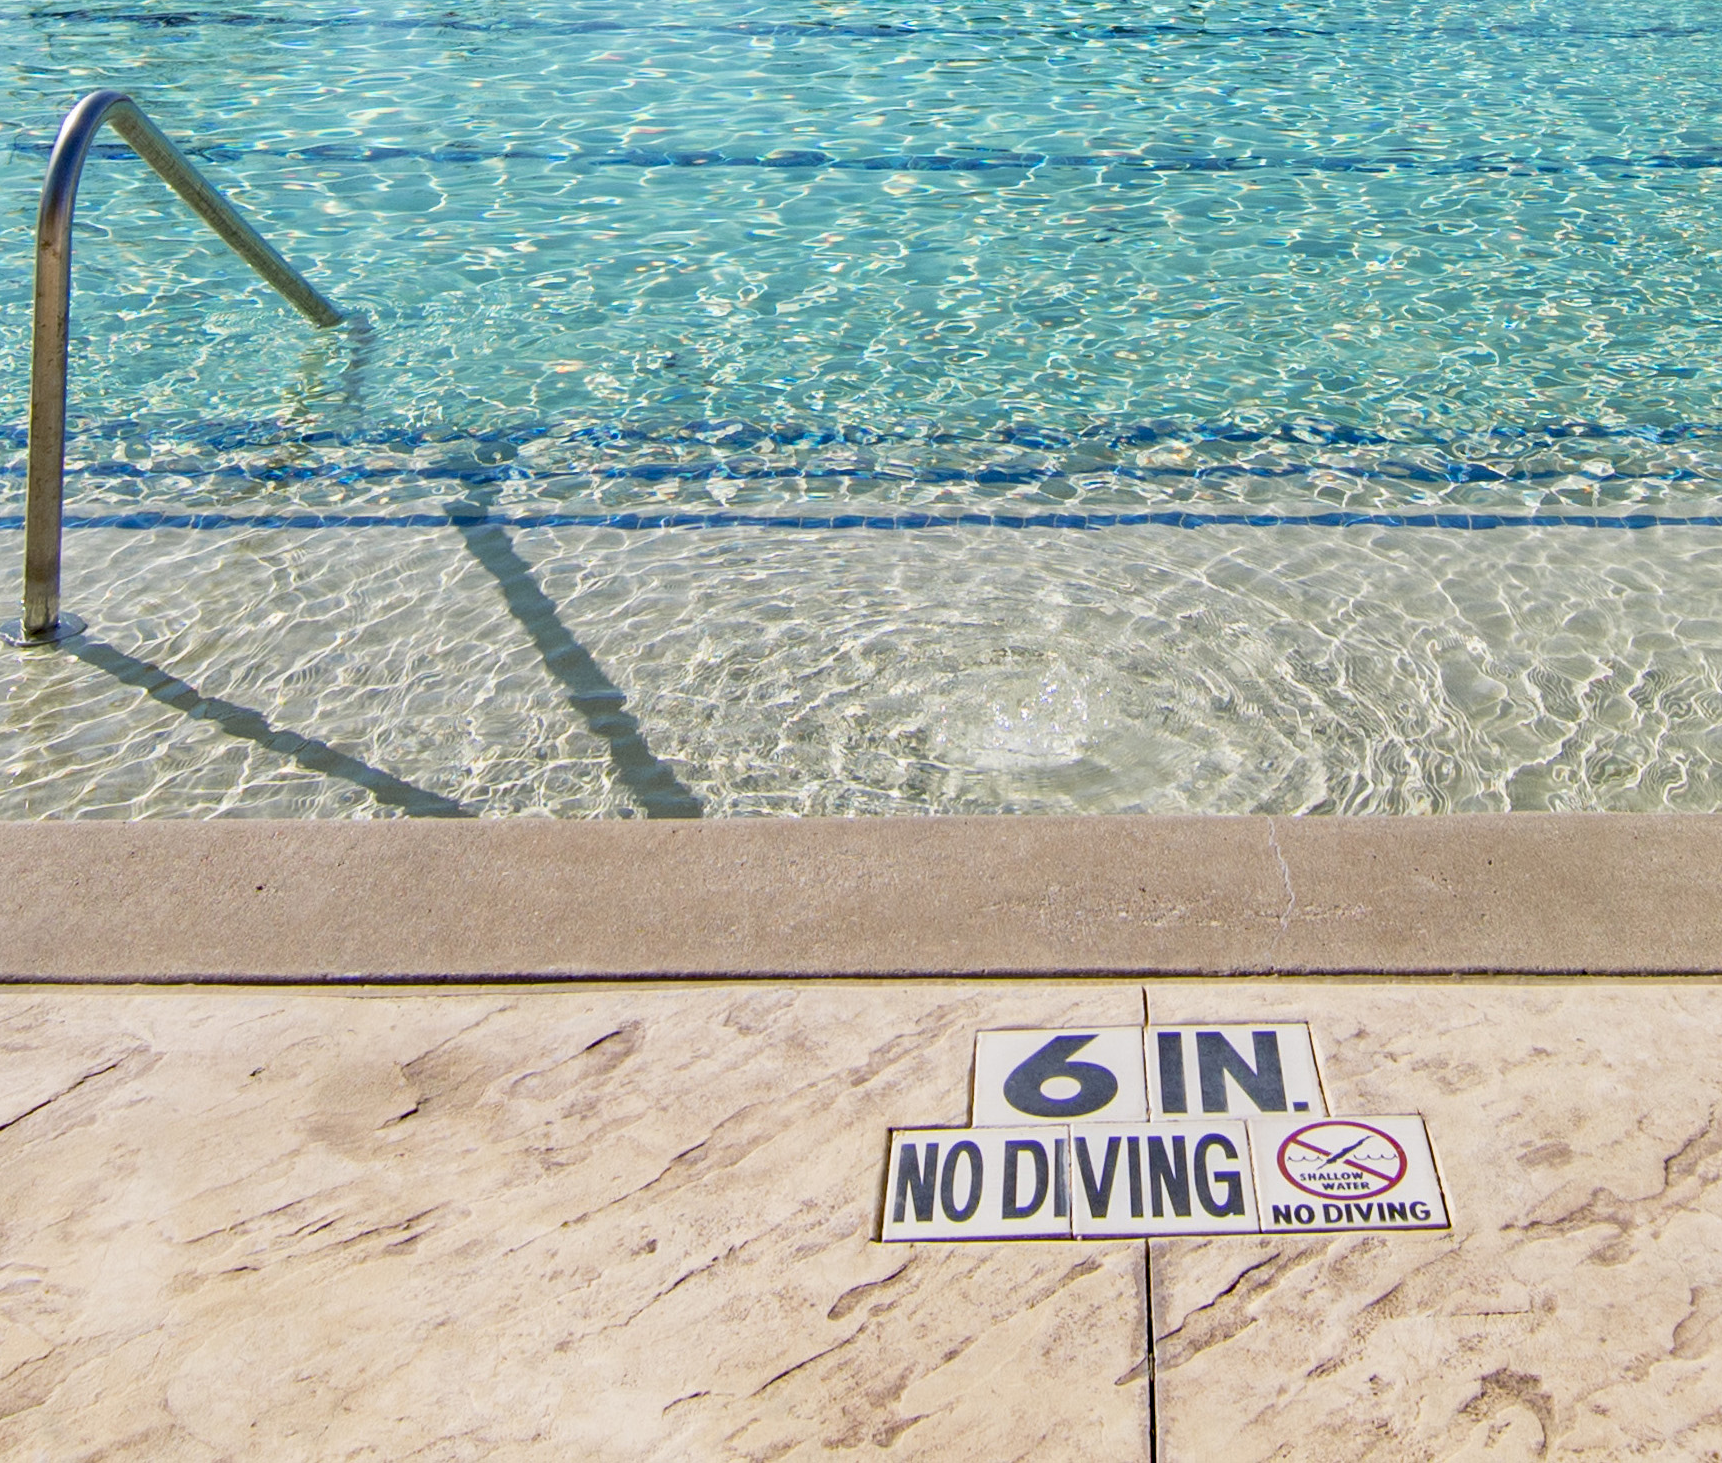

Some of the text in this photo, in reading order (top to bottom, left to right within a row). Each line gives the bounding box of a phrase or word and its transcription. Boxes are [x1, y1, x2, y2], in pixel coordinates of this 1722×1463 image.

[1003, 1030, 1310, 1118] 6 IN.
[892, 1132, 1246, 1224] NO DIVING
[1299, 1171, 1364, 1182] SHALLOW
[1321, 1181, 1371, 1191] WATER
[1272, 1200, 1432, 1225] NO DIVING
